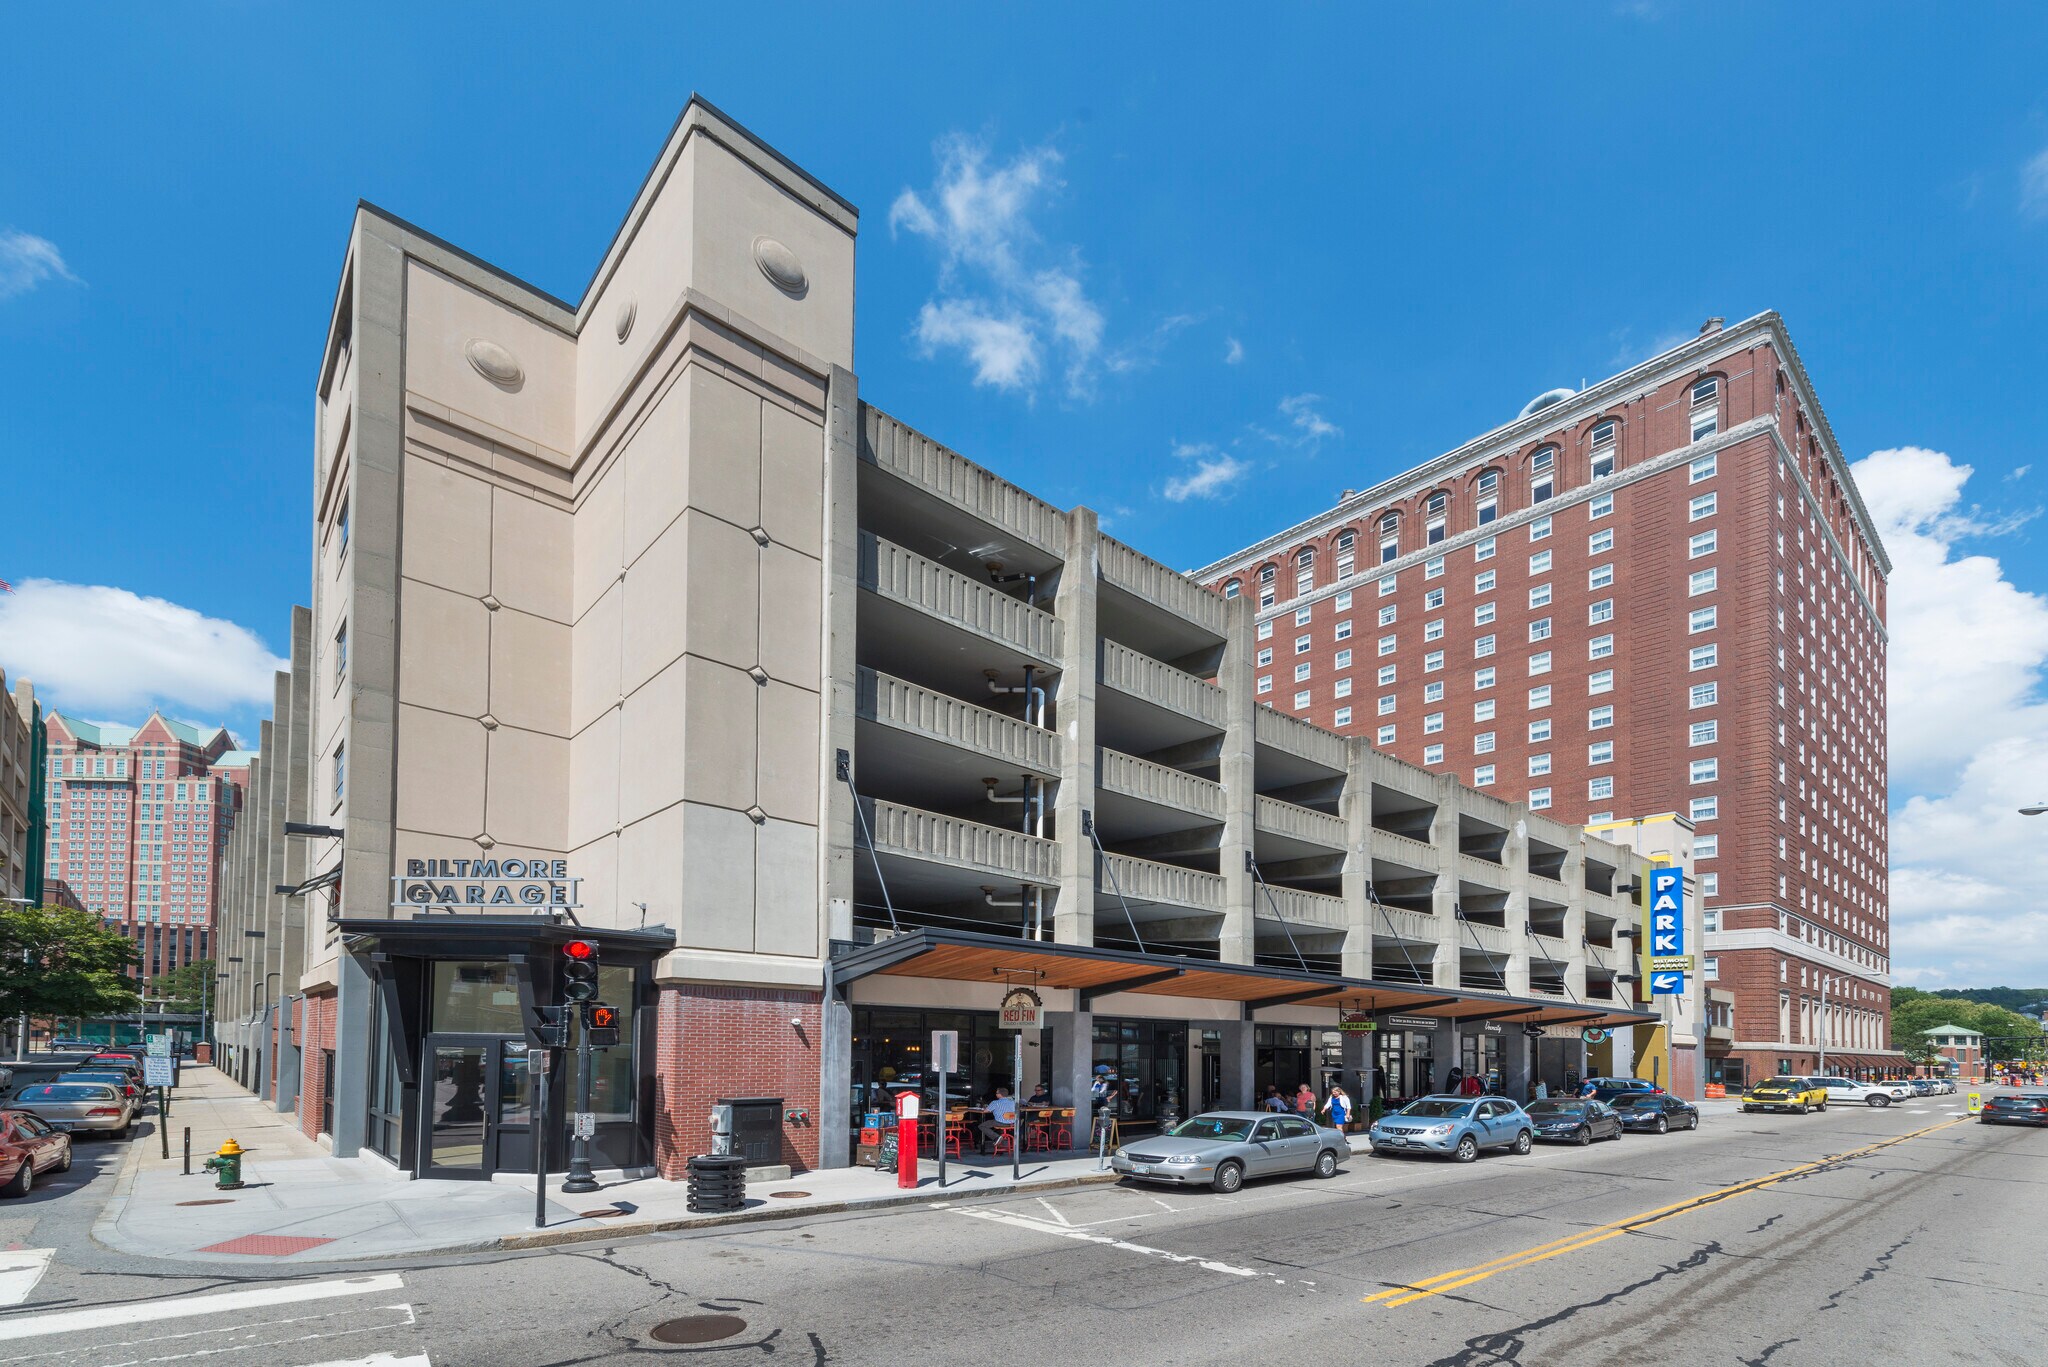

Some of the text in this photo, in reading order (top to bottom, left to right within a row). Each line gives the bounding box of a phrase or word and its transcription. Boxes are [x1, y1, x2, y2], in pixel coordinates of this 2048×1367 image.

[407, 859, 568, 878] BILTMORE
[407, 884, 566, 904] GARAGE
[1653, 875, 1678, 951] PARK
[1653, 957, 1689, 965] BILTMORE
[1003, 1009, 1036, 1022] RED FIN
